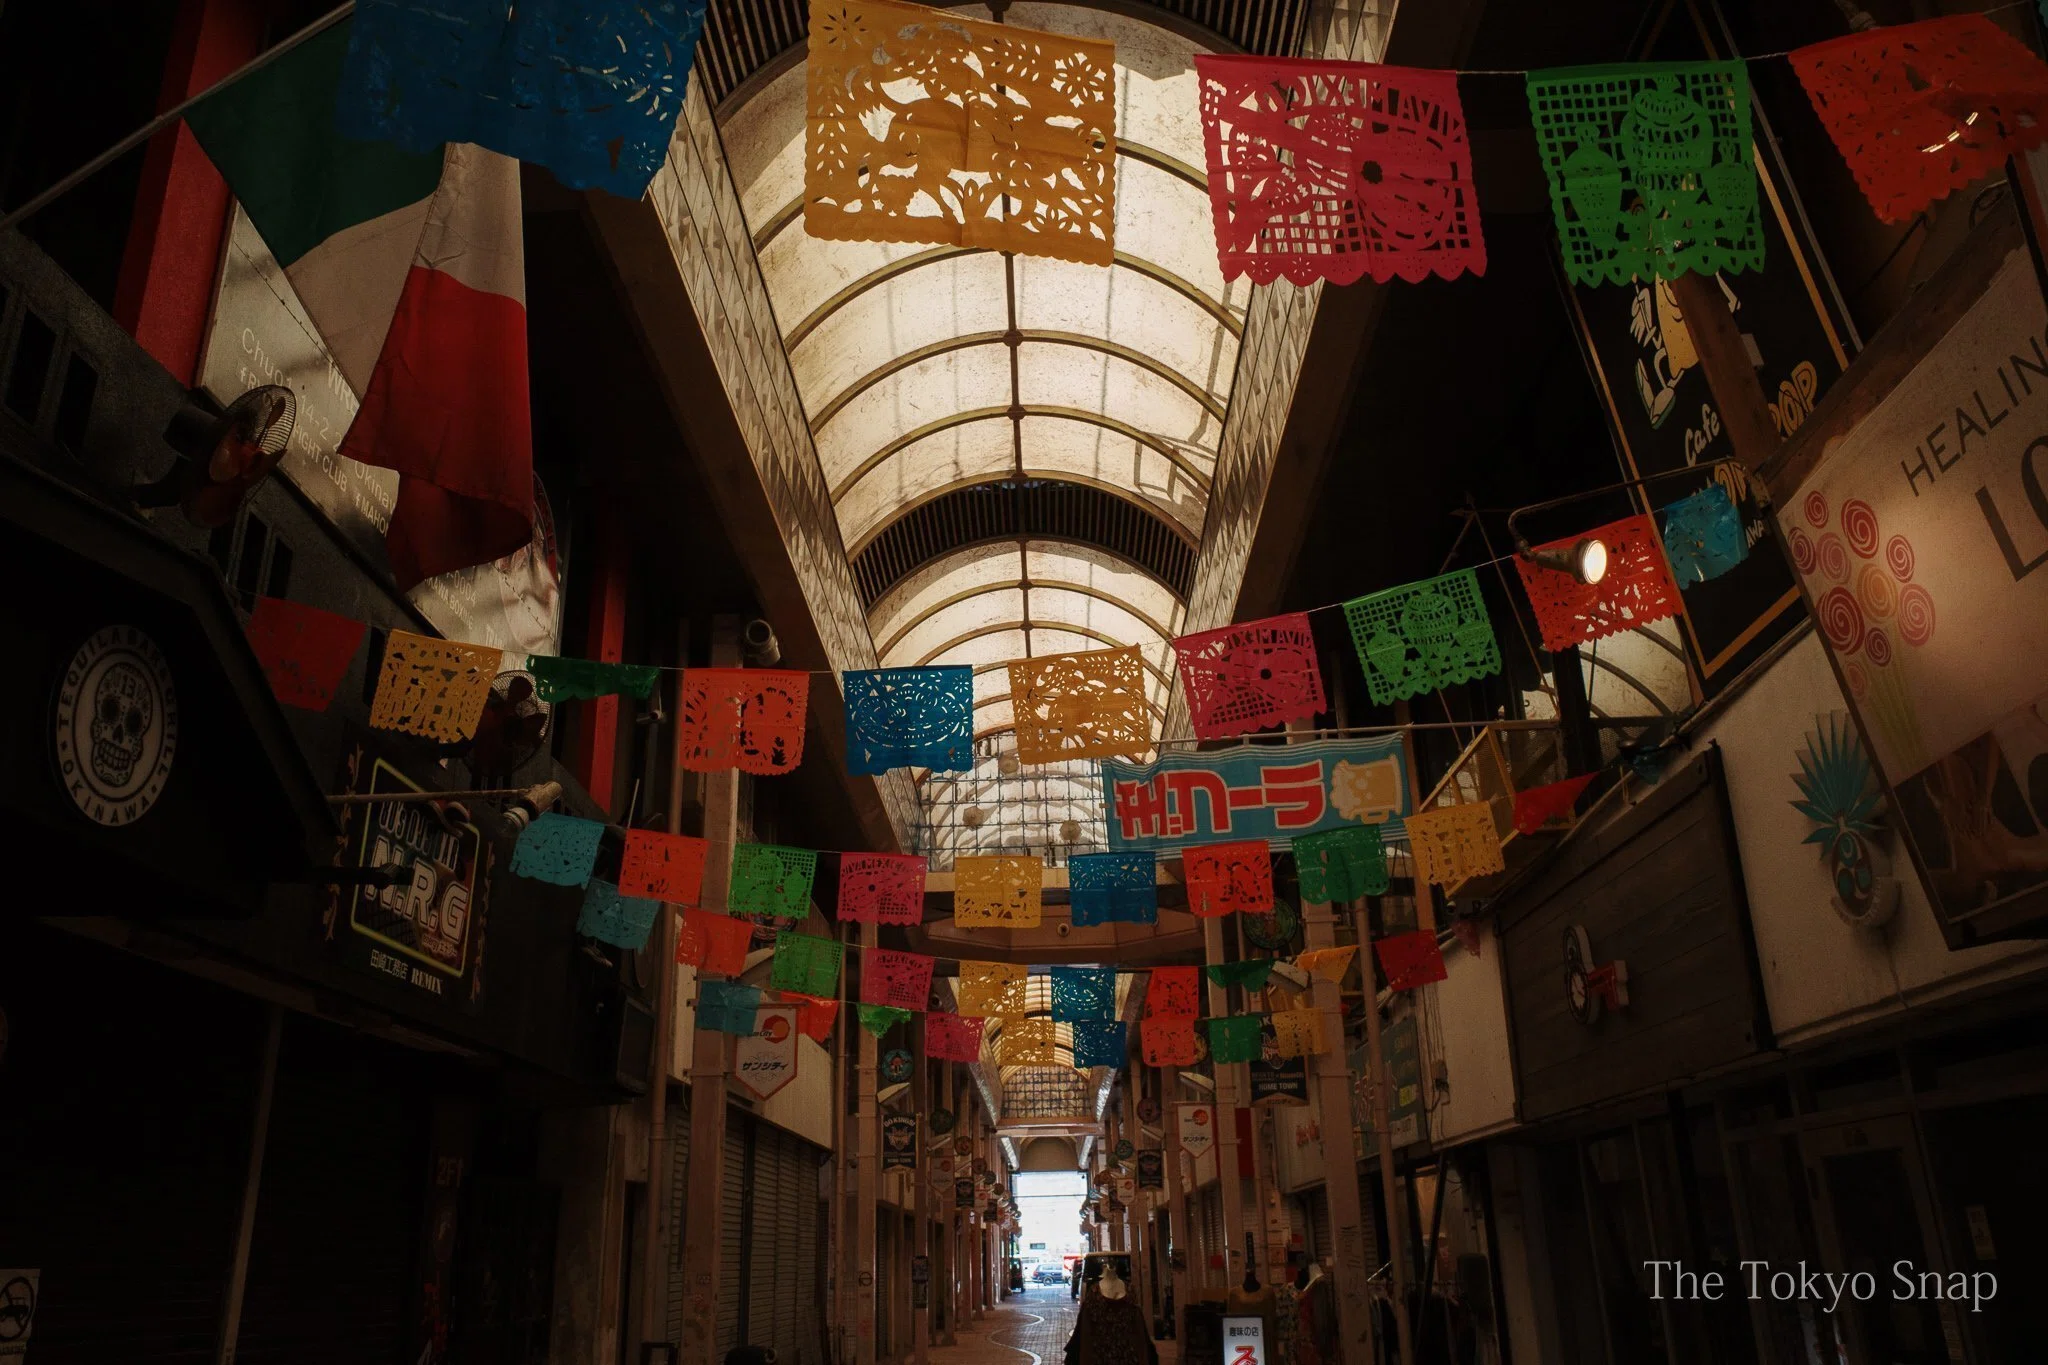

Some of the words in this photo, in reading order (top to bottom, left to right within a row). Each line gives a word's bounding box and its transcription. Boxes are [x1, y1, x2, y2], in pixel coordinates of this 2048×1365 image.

[1684, 402, 1721, 467] Cafe
[1901, 328, 2048, 497] HEALIN
[322, 454, 348, 493] CLUB
[59, 627, 121, 725] TEQUILA
[156, 688, 177, 777] CHILL
[63, 759, 150, 824] OKINAWA
[364, 835, 470, 944] N.R.G
[411, 967, 444, 996] REMIX
[742, 1061, 788, 1071] サンシティ
[1258, 1083, 1277, 1092] HOME
[1279, 1082, 1298, 1091] TOWN
